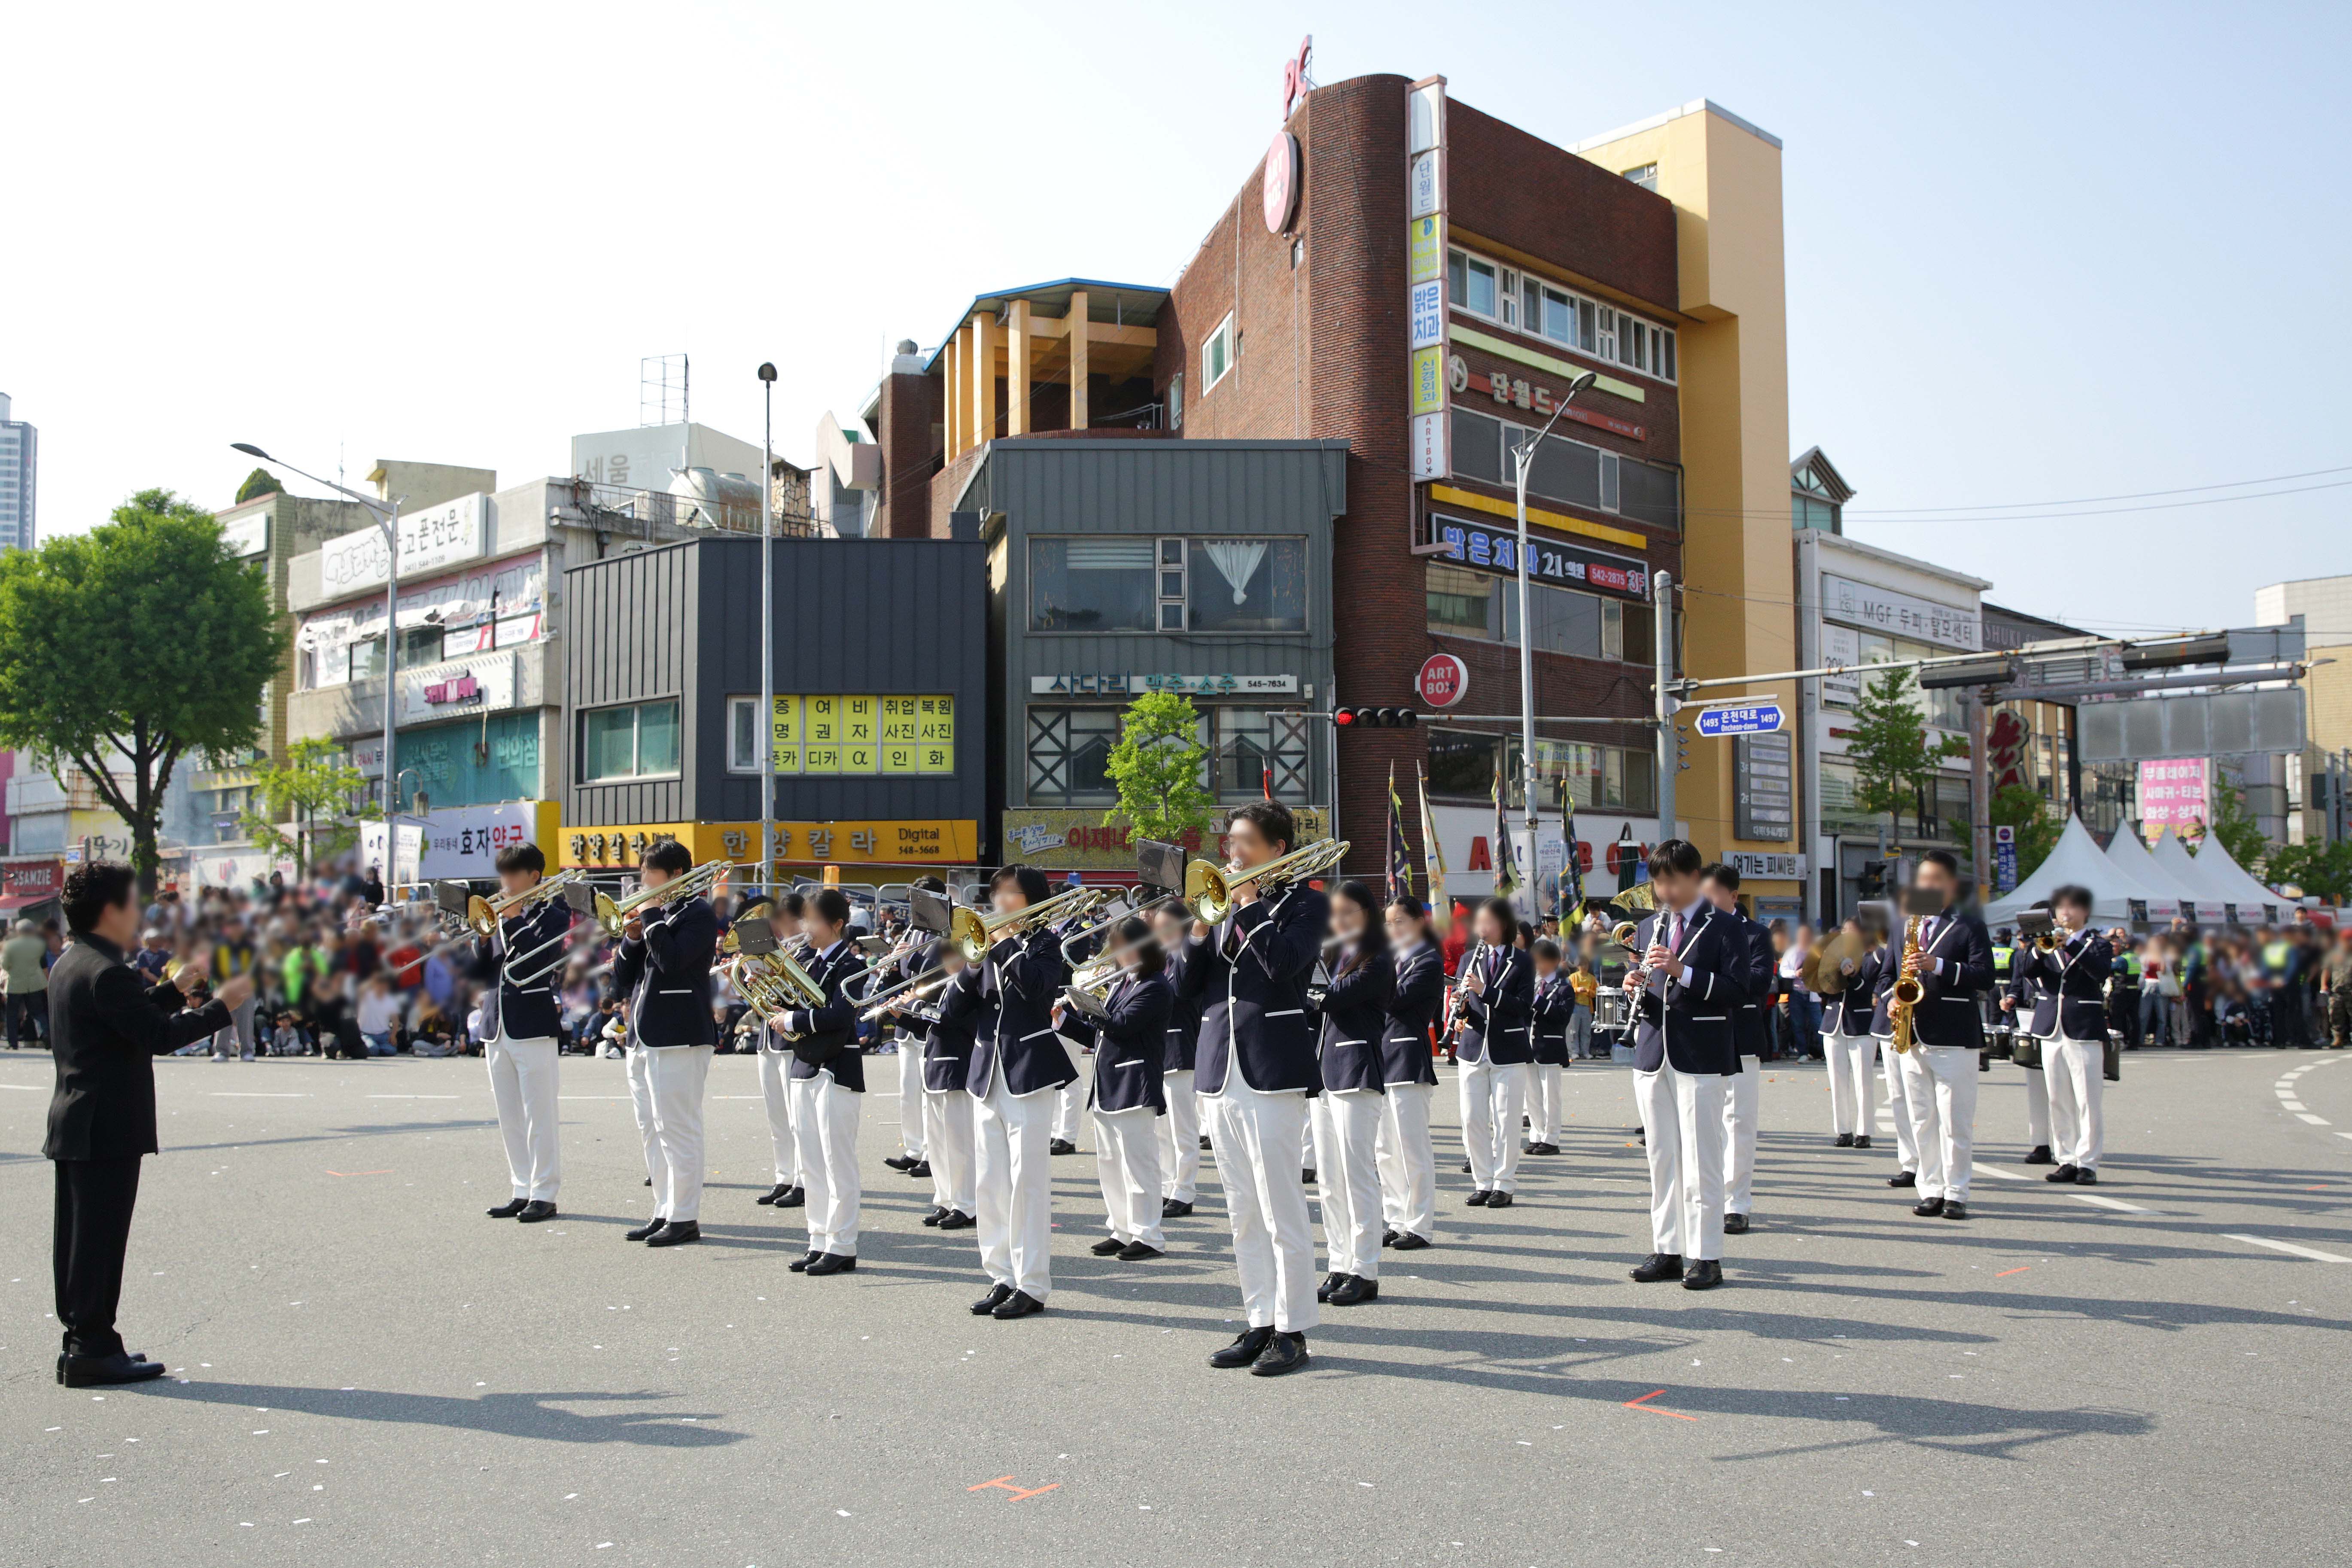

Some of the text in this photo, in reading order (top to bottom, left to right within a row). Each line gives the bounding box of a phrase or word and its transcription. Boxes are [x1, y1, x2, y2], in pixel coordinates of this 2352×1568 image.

[1266, 149, 1284, 187] ART
[1419, 161, 1432, 213] 단월드
[1415, 286, 1439, 313] 밝은
[1415, 314, 1439, 340] 치과
[1421, 359, 1436, 403] 신경외과
[1490, 372, 1552, 415] 단월드
[583, 454, 630, 484] 세움
[1542, 552, 1564, 578] 21
[1591, 568, 1625, 586] 542-2875
[1626, 569, 1645, 594] 3F
[1427, 666, 1454, 680] ART
[1050, 671, 1131, 698] 사다리
[1427, 681, 1455, 694] BOX
[885, 700, 914, 715] 취업
[922, 700, 951, 715] 복원
[1721, 709, 1758, 723] 온천대로
[1703, 718, 1719, 727] 1493
[1761, 713, 1777, 723] 1497
[885, 724, 914, 739] 사진
[922, 724, 951, 739] 사진
[809, 751, 837, 766] 디카
[898, 828, 939, 842] Digital
[570, 832, 647, 860] 한양칼라
[898, 845, 940, 855] 548-5668
[1734, 854, 1796, 875] 여기는 피씨방
